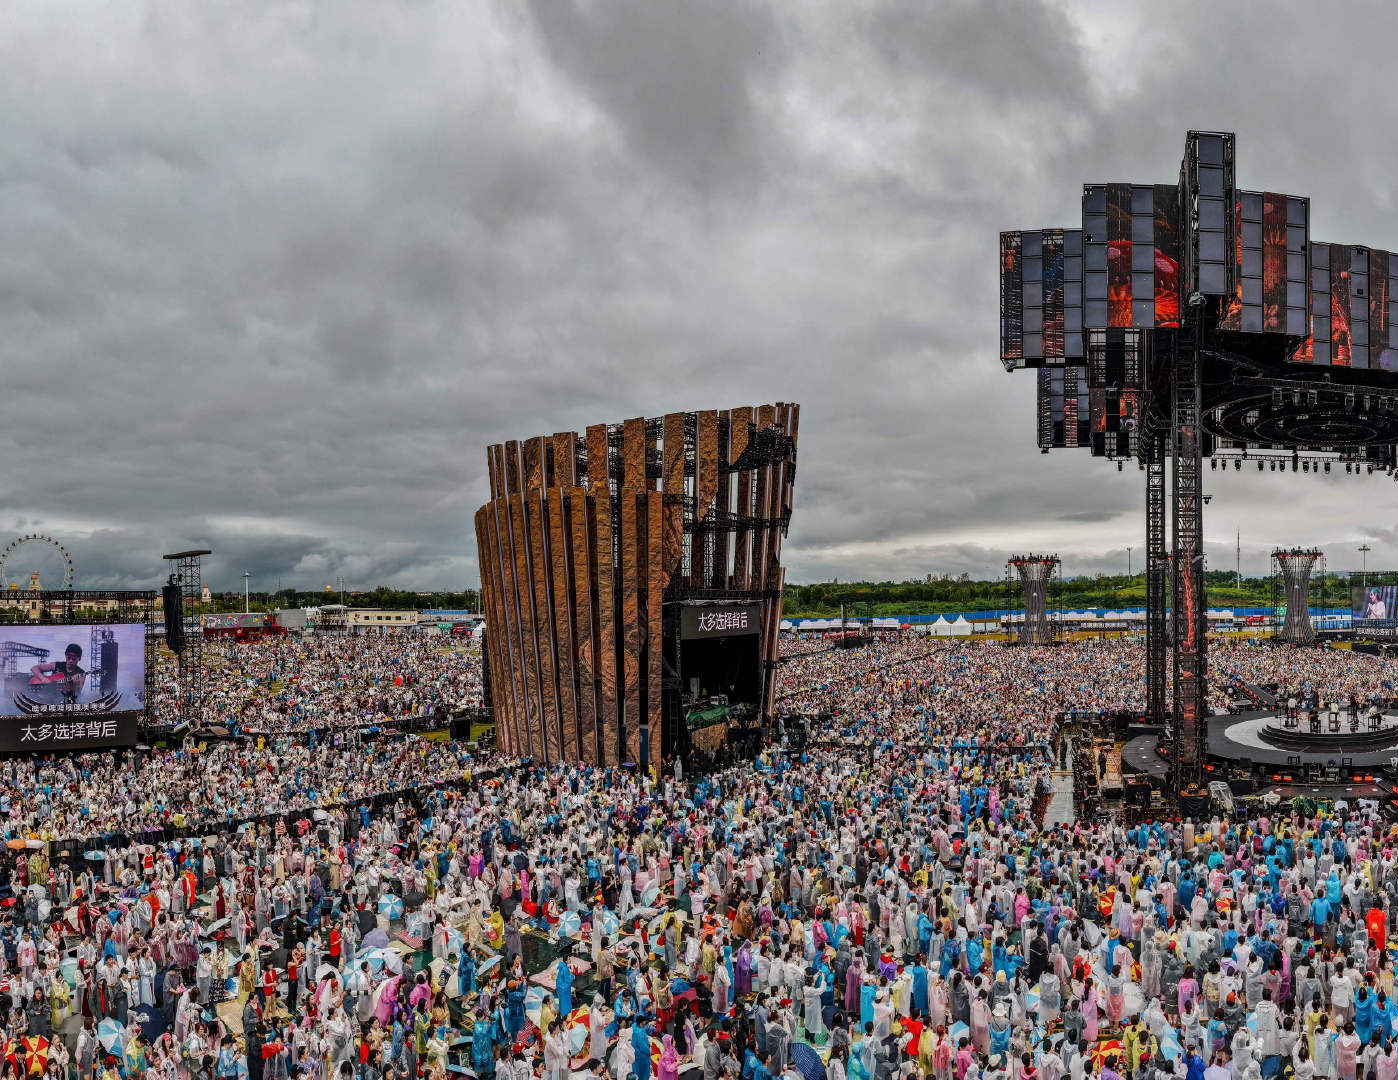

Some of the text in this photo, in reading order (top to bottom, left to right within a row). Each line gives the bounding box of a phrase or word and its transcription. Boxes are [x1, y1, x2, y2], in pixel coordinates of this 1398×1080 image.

[698, 611, 748, 632] 太多选择背后
[20, 720, 118, 742] 太多选择背后
